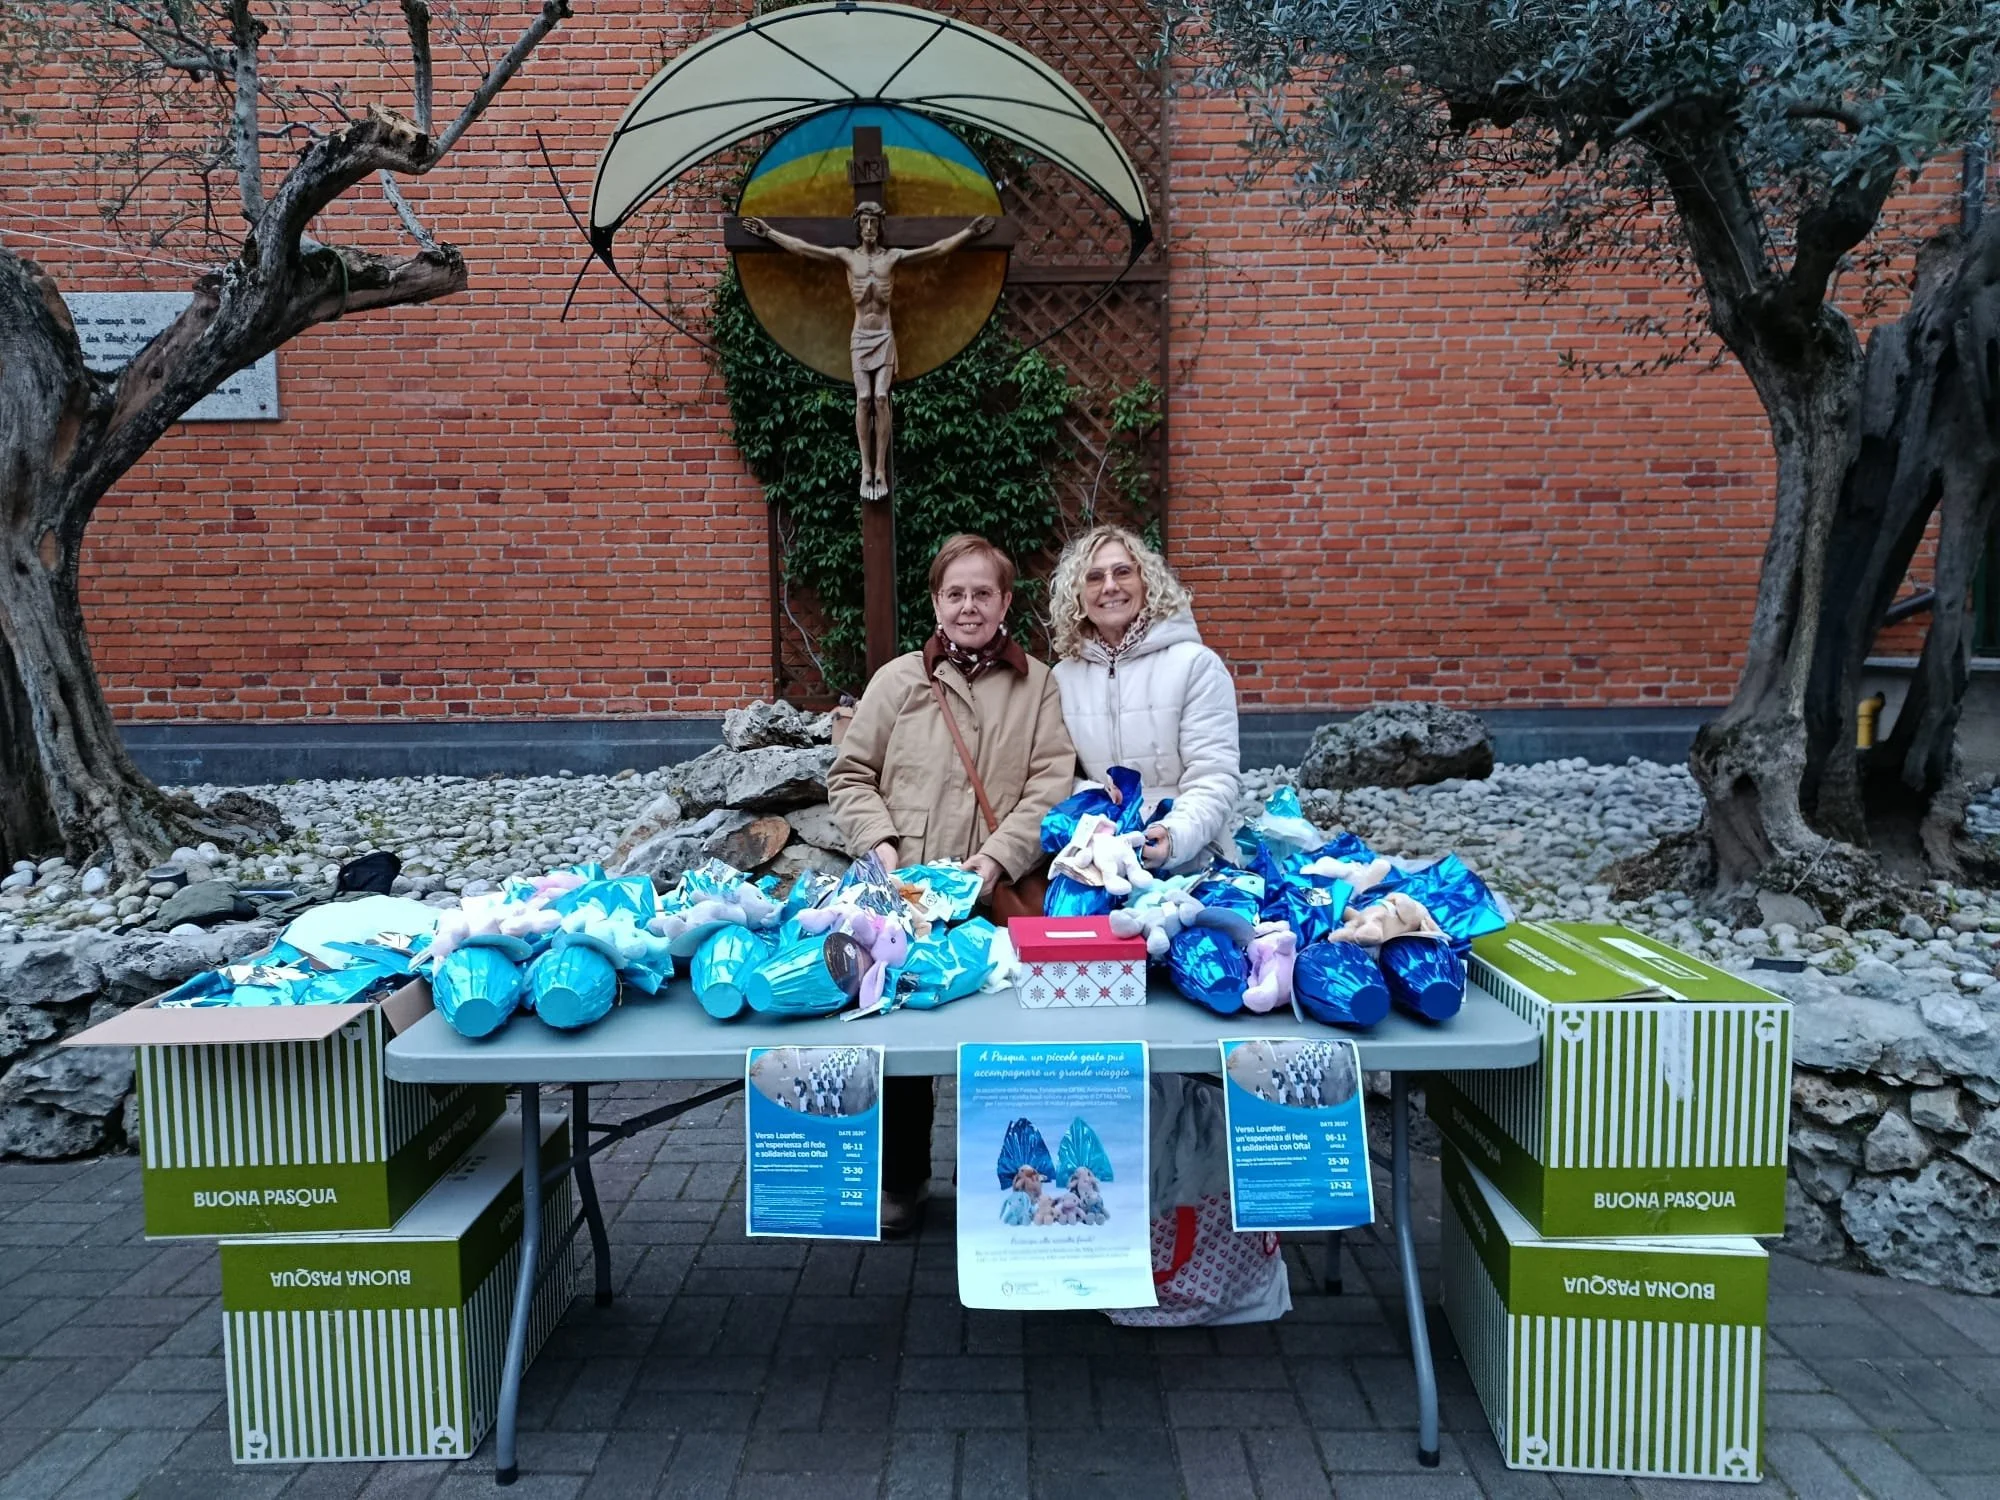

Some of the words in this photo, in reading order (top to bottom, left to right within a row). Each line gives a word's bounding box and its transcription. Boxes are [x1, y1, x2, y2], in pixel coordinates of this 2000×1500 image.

[979, 1050, 988, 1062] A
[1045, 1050, 1078, 1064] piccolo
[1080, 1052, 1105, 1064] gesto
[1106, 1052, 1125, 1064] può
[974, 1069, 1042, 1080] accompagnare
[1059, 1065, 1093, 1079] grande
[1095, 1068, 1130, 1080] viaggio
[755, 1141, 802, 1149] un'esperienza
[1236, 1135, 1283, 1143] un'esperienza
[1284, 1133, 1291, 1141] di
[1242, 1143, 1278, 1152] solidarietà
[1293, 1142, 1311, 1150] Oftal
[1328, 1157, 1350, 1166] 25-30
[842, 1166, 863, 1175] 25-30
[1330, 1181, 1352, 1190] 17-22
[193, 1190, 260, 1207] BUONA
[263, 1188, 338, 1207] PASQUA
[841, 1191, 863, 1199] 17-22
[1594, 1192, 1660, 1209] BUONA
[1664, 1191, 1736, 1211] PASQUA
[270, 1268, 342, 1287] PASQUA
[345, 1269, 411, 1286] BUONA
[1563, 1274, 1641, 1297] PASQUA
[1644, 1280, 1715, 1300] BUONA
